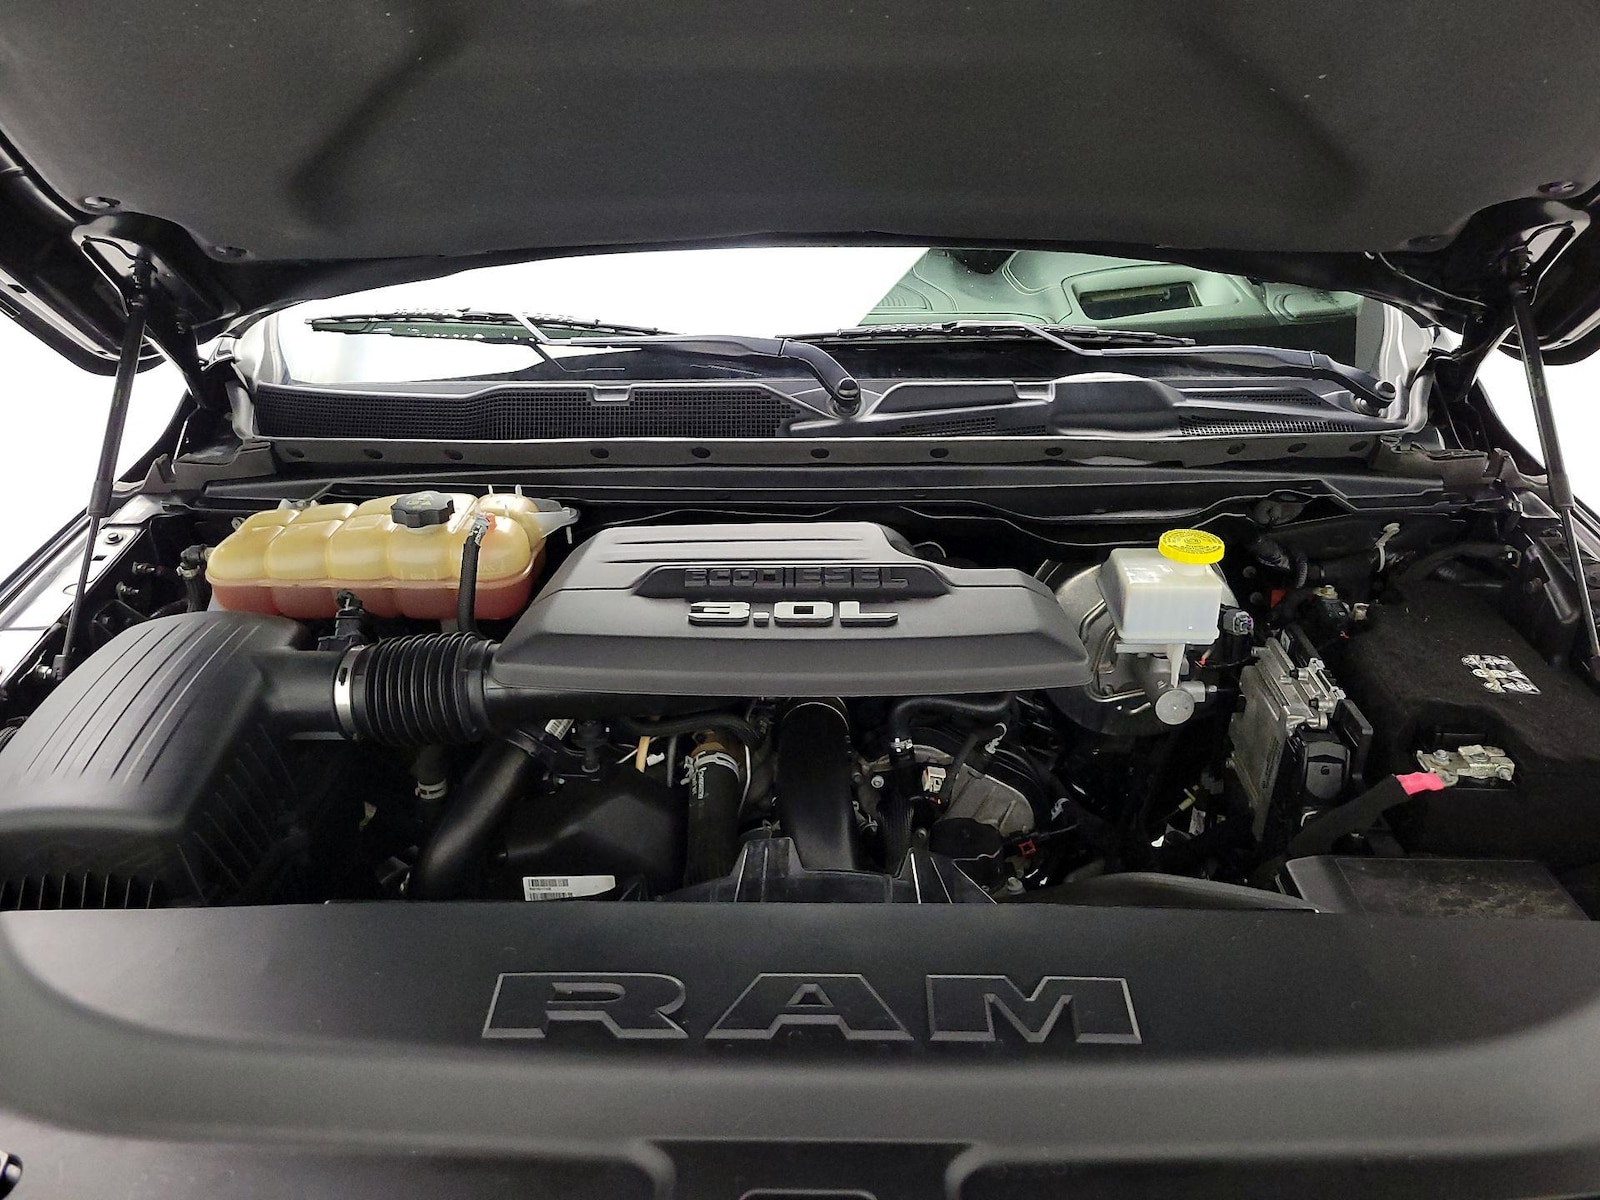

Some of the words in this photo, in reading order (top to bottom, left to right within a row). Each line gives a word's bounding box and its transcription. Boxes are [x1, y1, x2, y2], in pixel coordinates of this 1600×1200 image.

[685, 568, 909, 589] ECODIESEL
[688, 601, 899, 627] 3.0L
[481, 971, 1142, 1045] RAM
